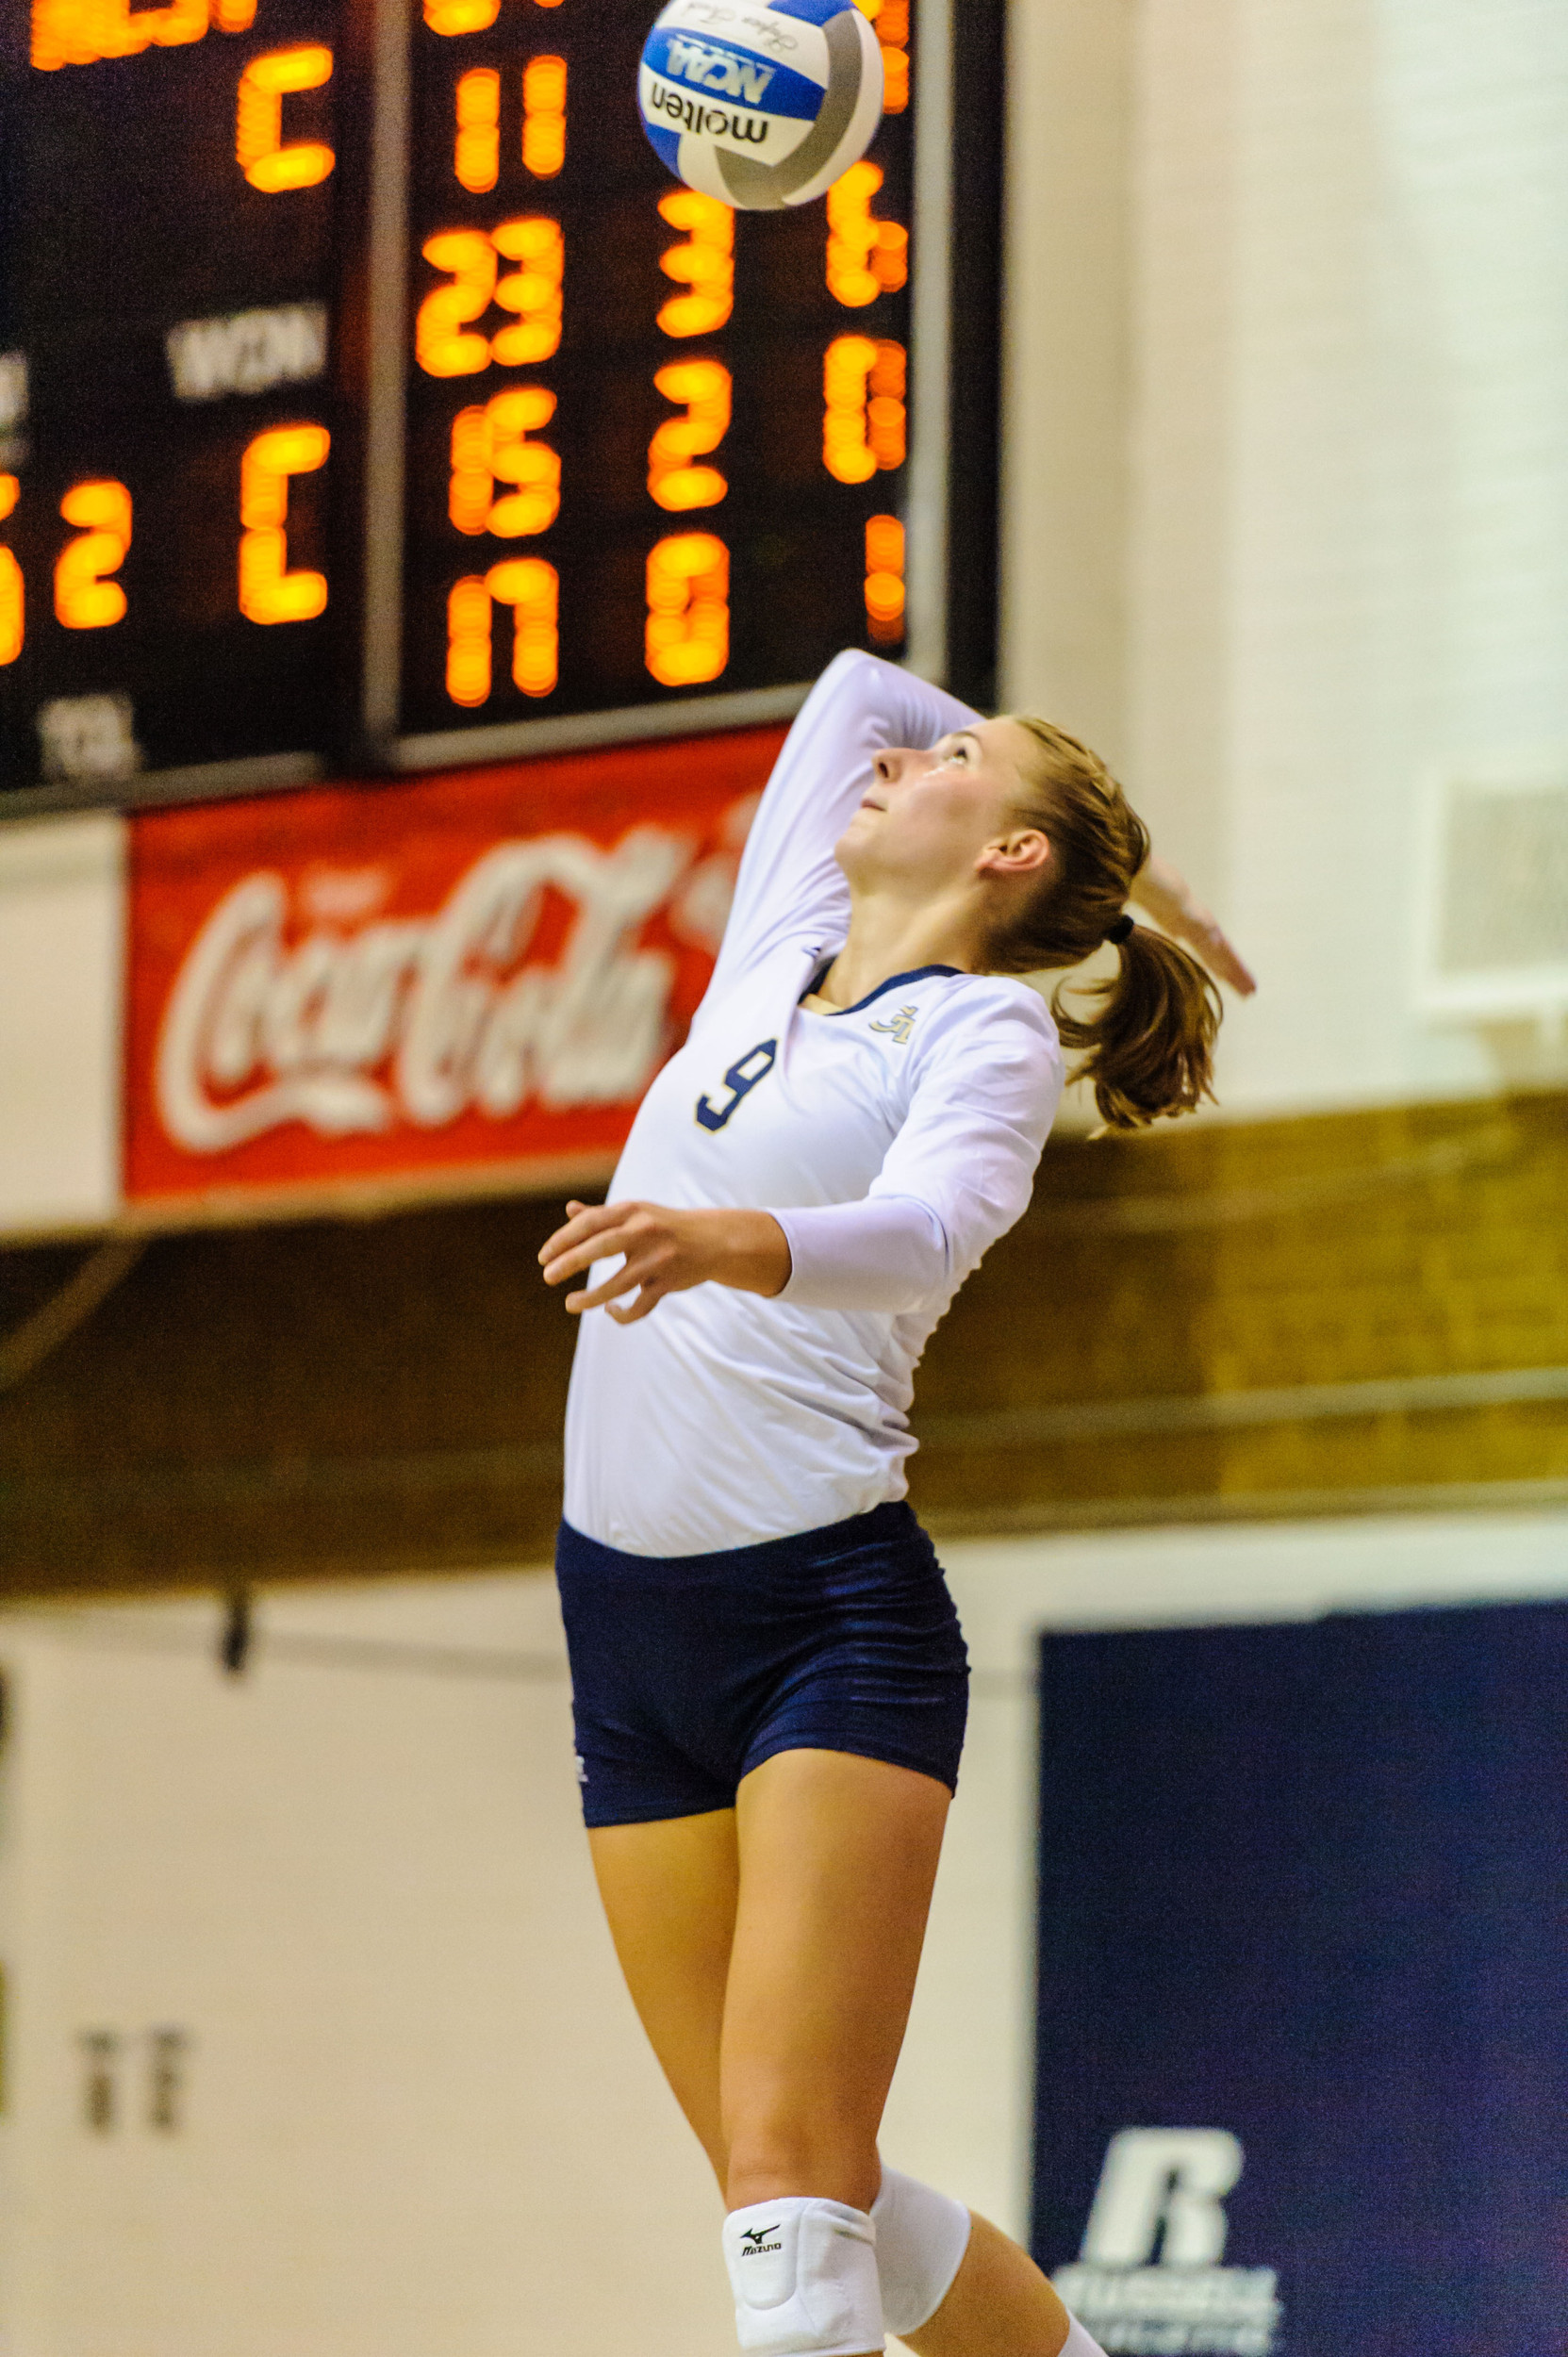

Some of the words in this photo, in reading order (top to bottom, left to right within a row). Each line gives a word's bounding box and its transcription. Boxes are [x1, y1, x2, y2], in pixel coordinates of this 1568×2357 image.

[454, 55, 568, 194] 11
[651, 81, 769, 143] molten
[666, 34, 776, 105] NCAA
[416, 217, 565, 378] 23
[657, 189, 735, 338] 3
[449, 387, 562, 538] 15
[647, 359, 733, 512] 2
[54, 480, 133, 629] 2
[446, 558, 559, 708] 17
[695, 1038, 778, 1133] 9
[1080, 2125, 1245, 2266] R
